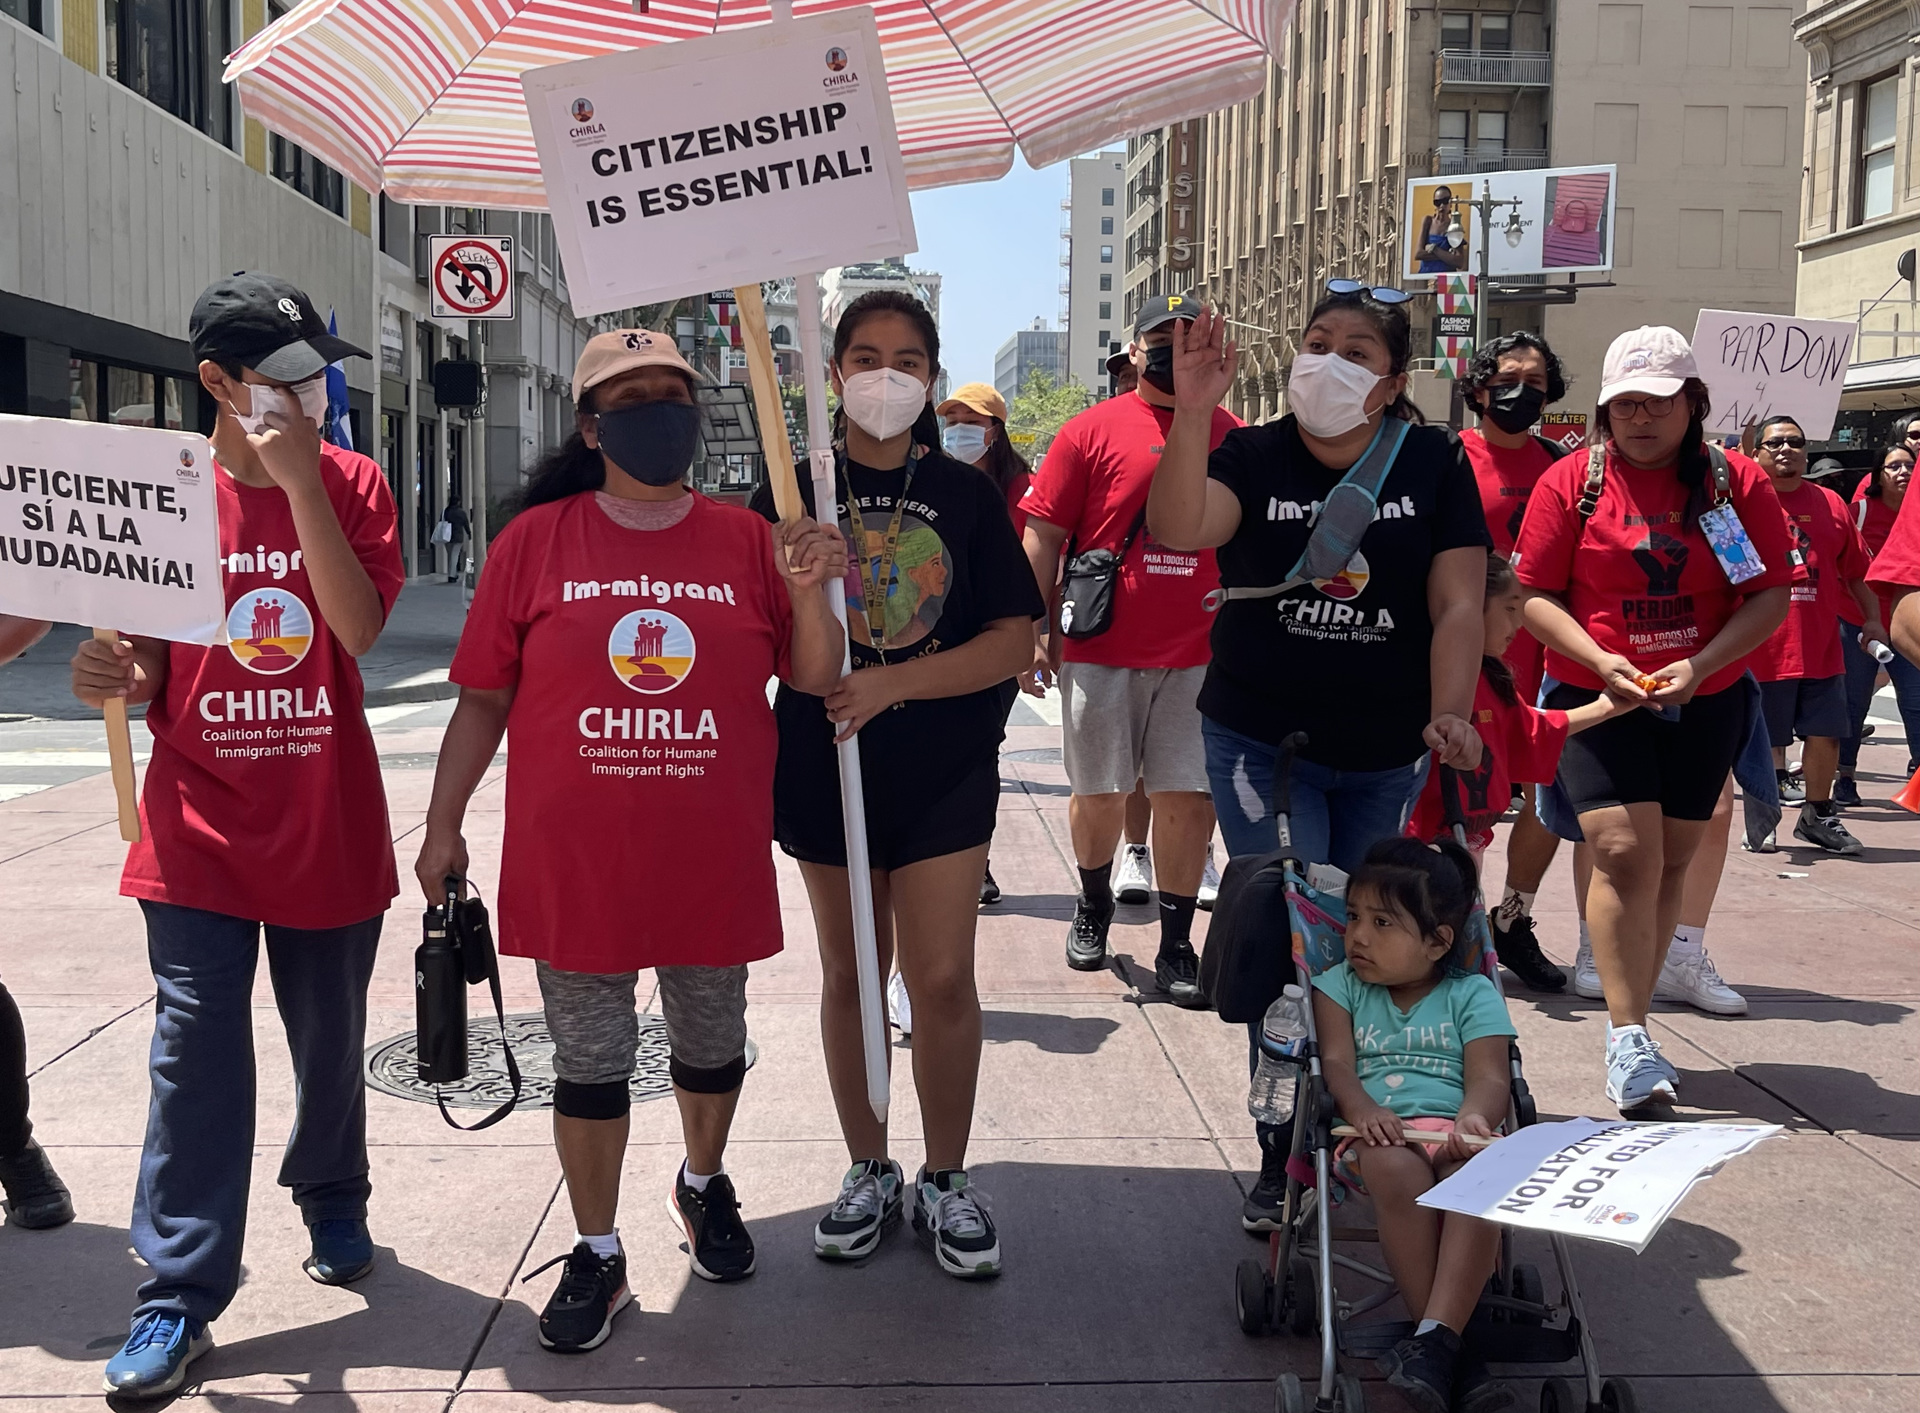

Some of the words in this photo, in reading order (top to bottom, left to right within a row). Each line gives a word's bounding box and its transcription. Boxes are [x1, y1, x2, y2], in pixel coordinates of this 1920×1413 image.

[823, 72, 858, 87] CHIRLA
[569, 123, 606, 138] CHIRLA
[591, 102, 847, 177] CITIZENSHIP
[586, 195, 627, 228] IS
[639, 146, 873, 218] ESSENTIAL!
[1168, 296, 1182, 311] P
[1441, 317, 1471, 325] FASHION
[1441, 324, 1470, 332] DISTRICT
[1720, 322, 1850, 386] PARDON
[1755, 381, 1767, 401] 4
[1544, 414, 1586, 424] THEATER
[0, 465, 187, 522] UFICIENTE,
[876, 496, 892, 507] IS
[895, 499, 939, 521] HERE
[22, 499, 54, 532] SÍ
[67, 509, 87, 537] A
[97, 513, 142, 545] LA
[884, 546, 895, 565] UCR
[1143, 554, 1162, 564] PARA
[1163, 554, 1184, 565] TODOS
[1185, 555, 1198, 567] LOS
[1146, 565, 1194, 577] INMIGRANTES
[1288, 625, 1348, 641] Immigrant
[1629, 633, 1652, 645] PARA
[199, 686, 333, 722] CHIRLA
[578, 707, 719, 740] CHIRLA
[202, 727, 262, 742] Coalition
[266, 725, 285, 739] for
[287, 724, 333, 738] Humane
[215, 744, 285, 760] Immigrant
[288, 742, 322, 758] Rights
[579, 745, 638, 759] Coalition
[642, 745, 662, 759] for
[665, 747, 717, 759] Humane
[592, 762, 661, 778] Immigrant
[666, 763, 705, 776] Rights
[1355, 1023, 1397, 1053] AKE
[1403, 1022, 1454, 1051] THE
[1606, 1126, 1701, 1162] UNITED
[1553, 1166, 1620, 1209] FOR
